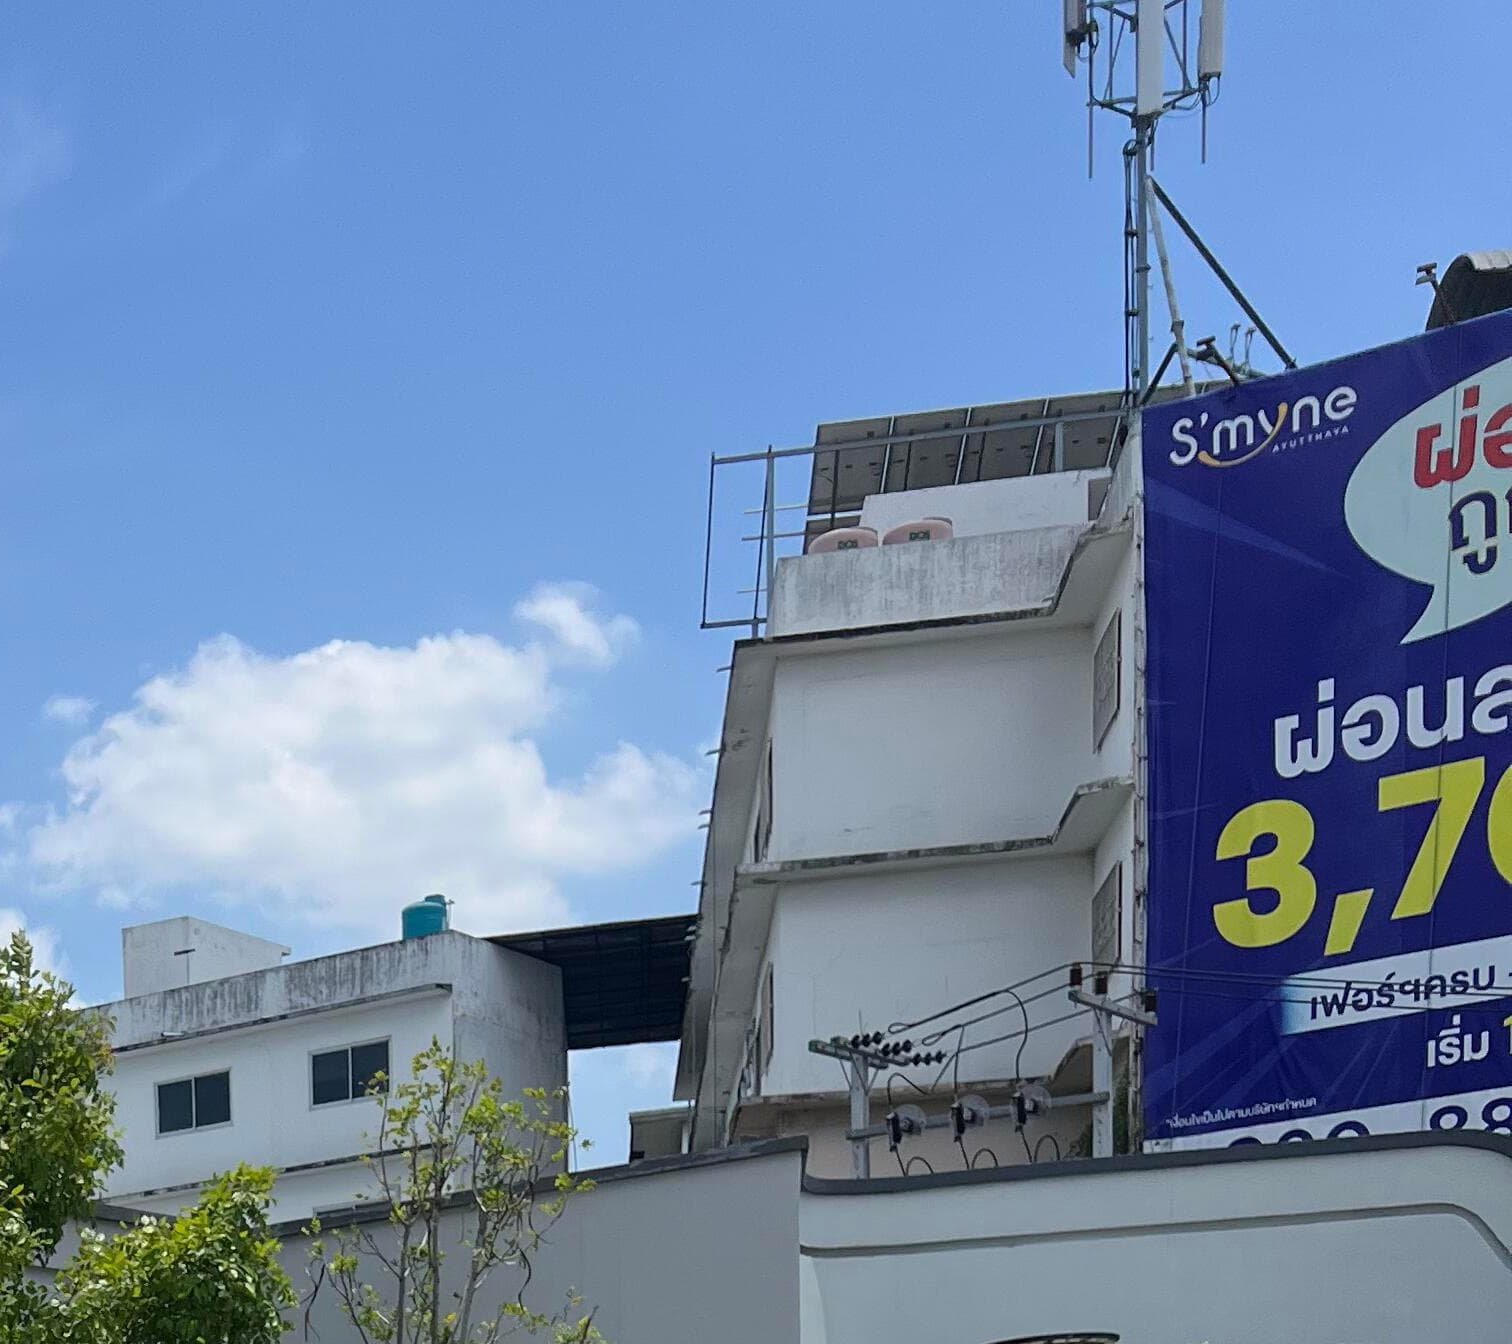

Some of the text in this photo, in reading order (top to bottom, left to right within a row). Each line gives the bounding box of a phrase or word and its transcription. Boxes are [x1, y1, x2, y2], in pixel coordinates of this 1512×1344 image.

[1169, 386, 1358, 467] S'myne
[1212, 756, 1512, 957] 3,7
[1426, 1013, 1490, 1068] เริ่ม
